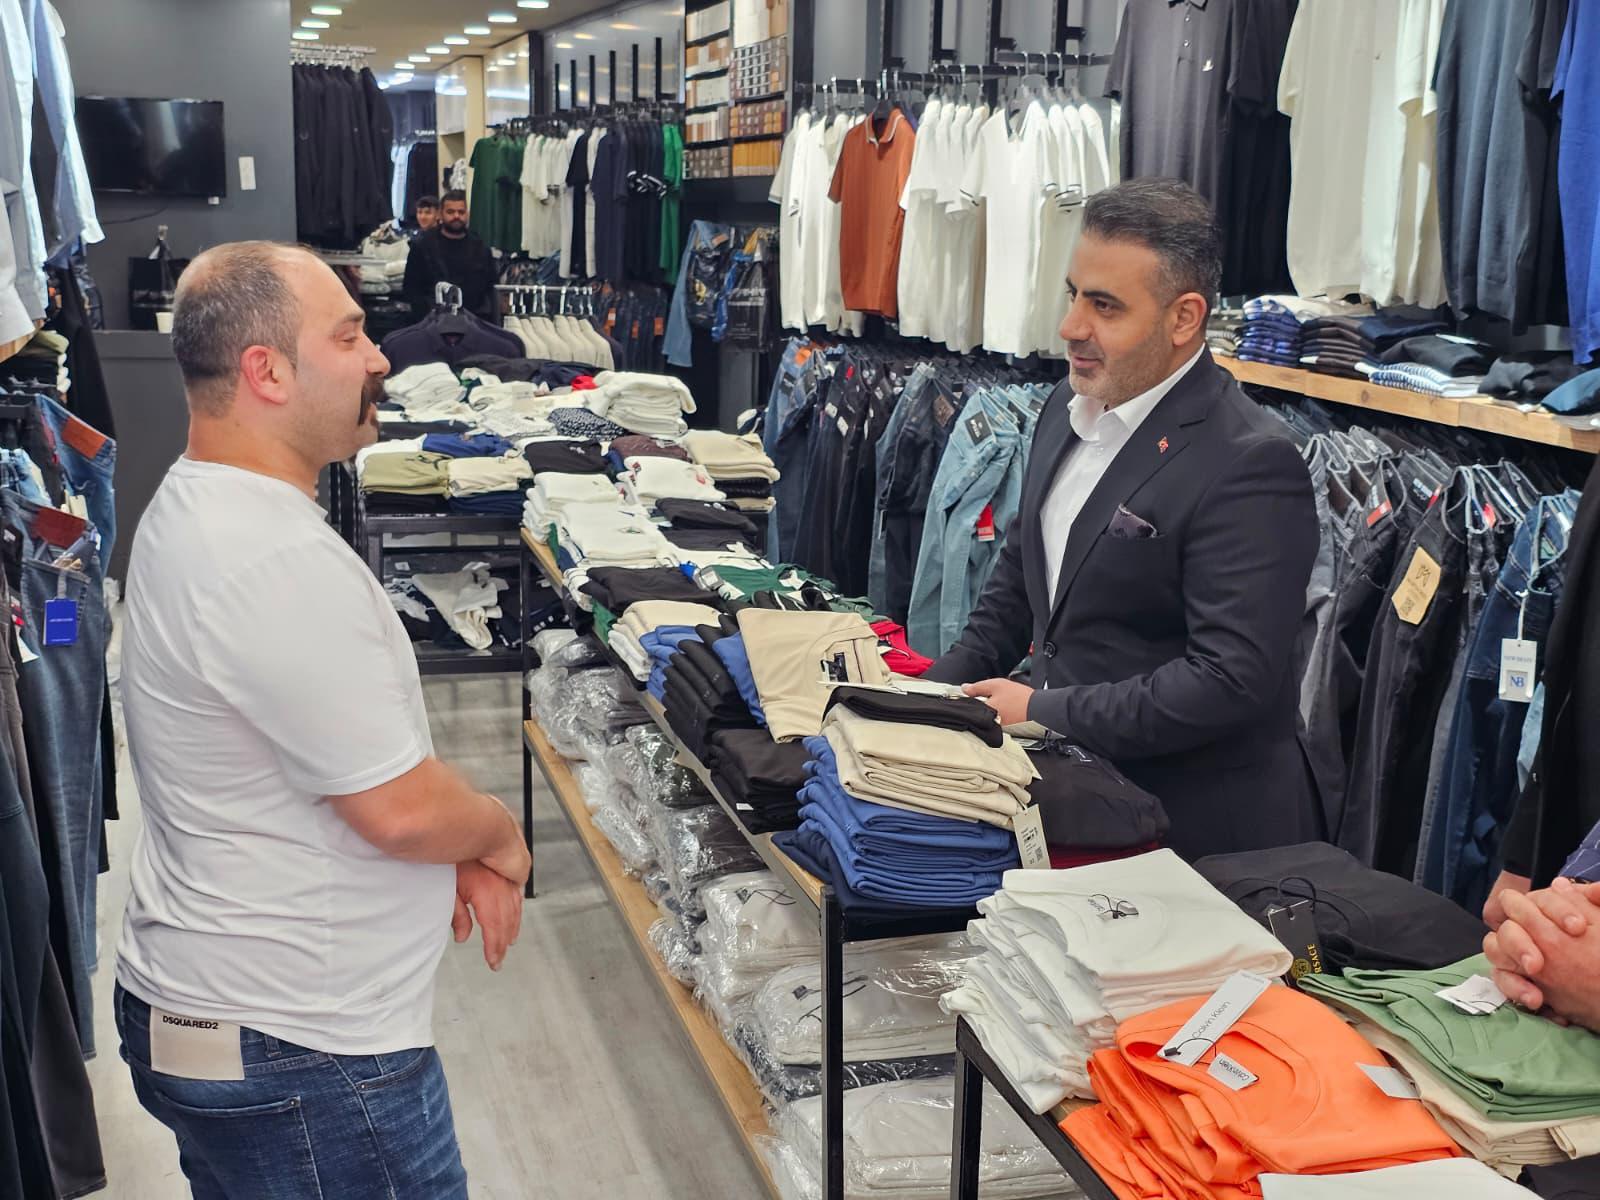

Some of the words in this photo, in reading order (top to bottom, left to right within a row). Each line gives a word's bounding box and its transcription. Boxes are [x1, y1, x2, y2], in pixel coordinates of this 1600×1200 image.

[1307, 943, 1322, 974] RSACE
[162, 1015, 219, 1030] DSQUARED2
[1191, 1016, 1215, 1040] Calvin
[1211, 1001, 1231, 1019] Klein
